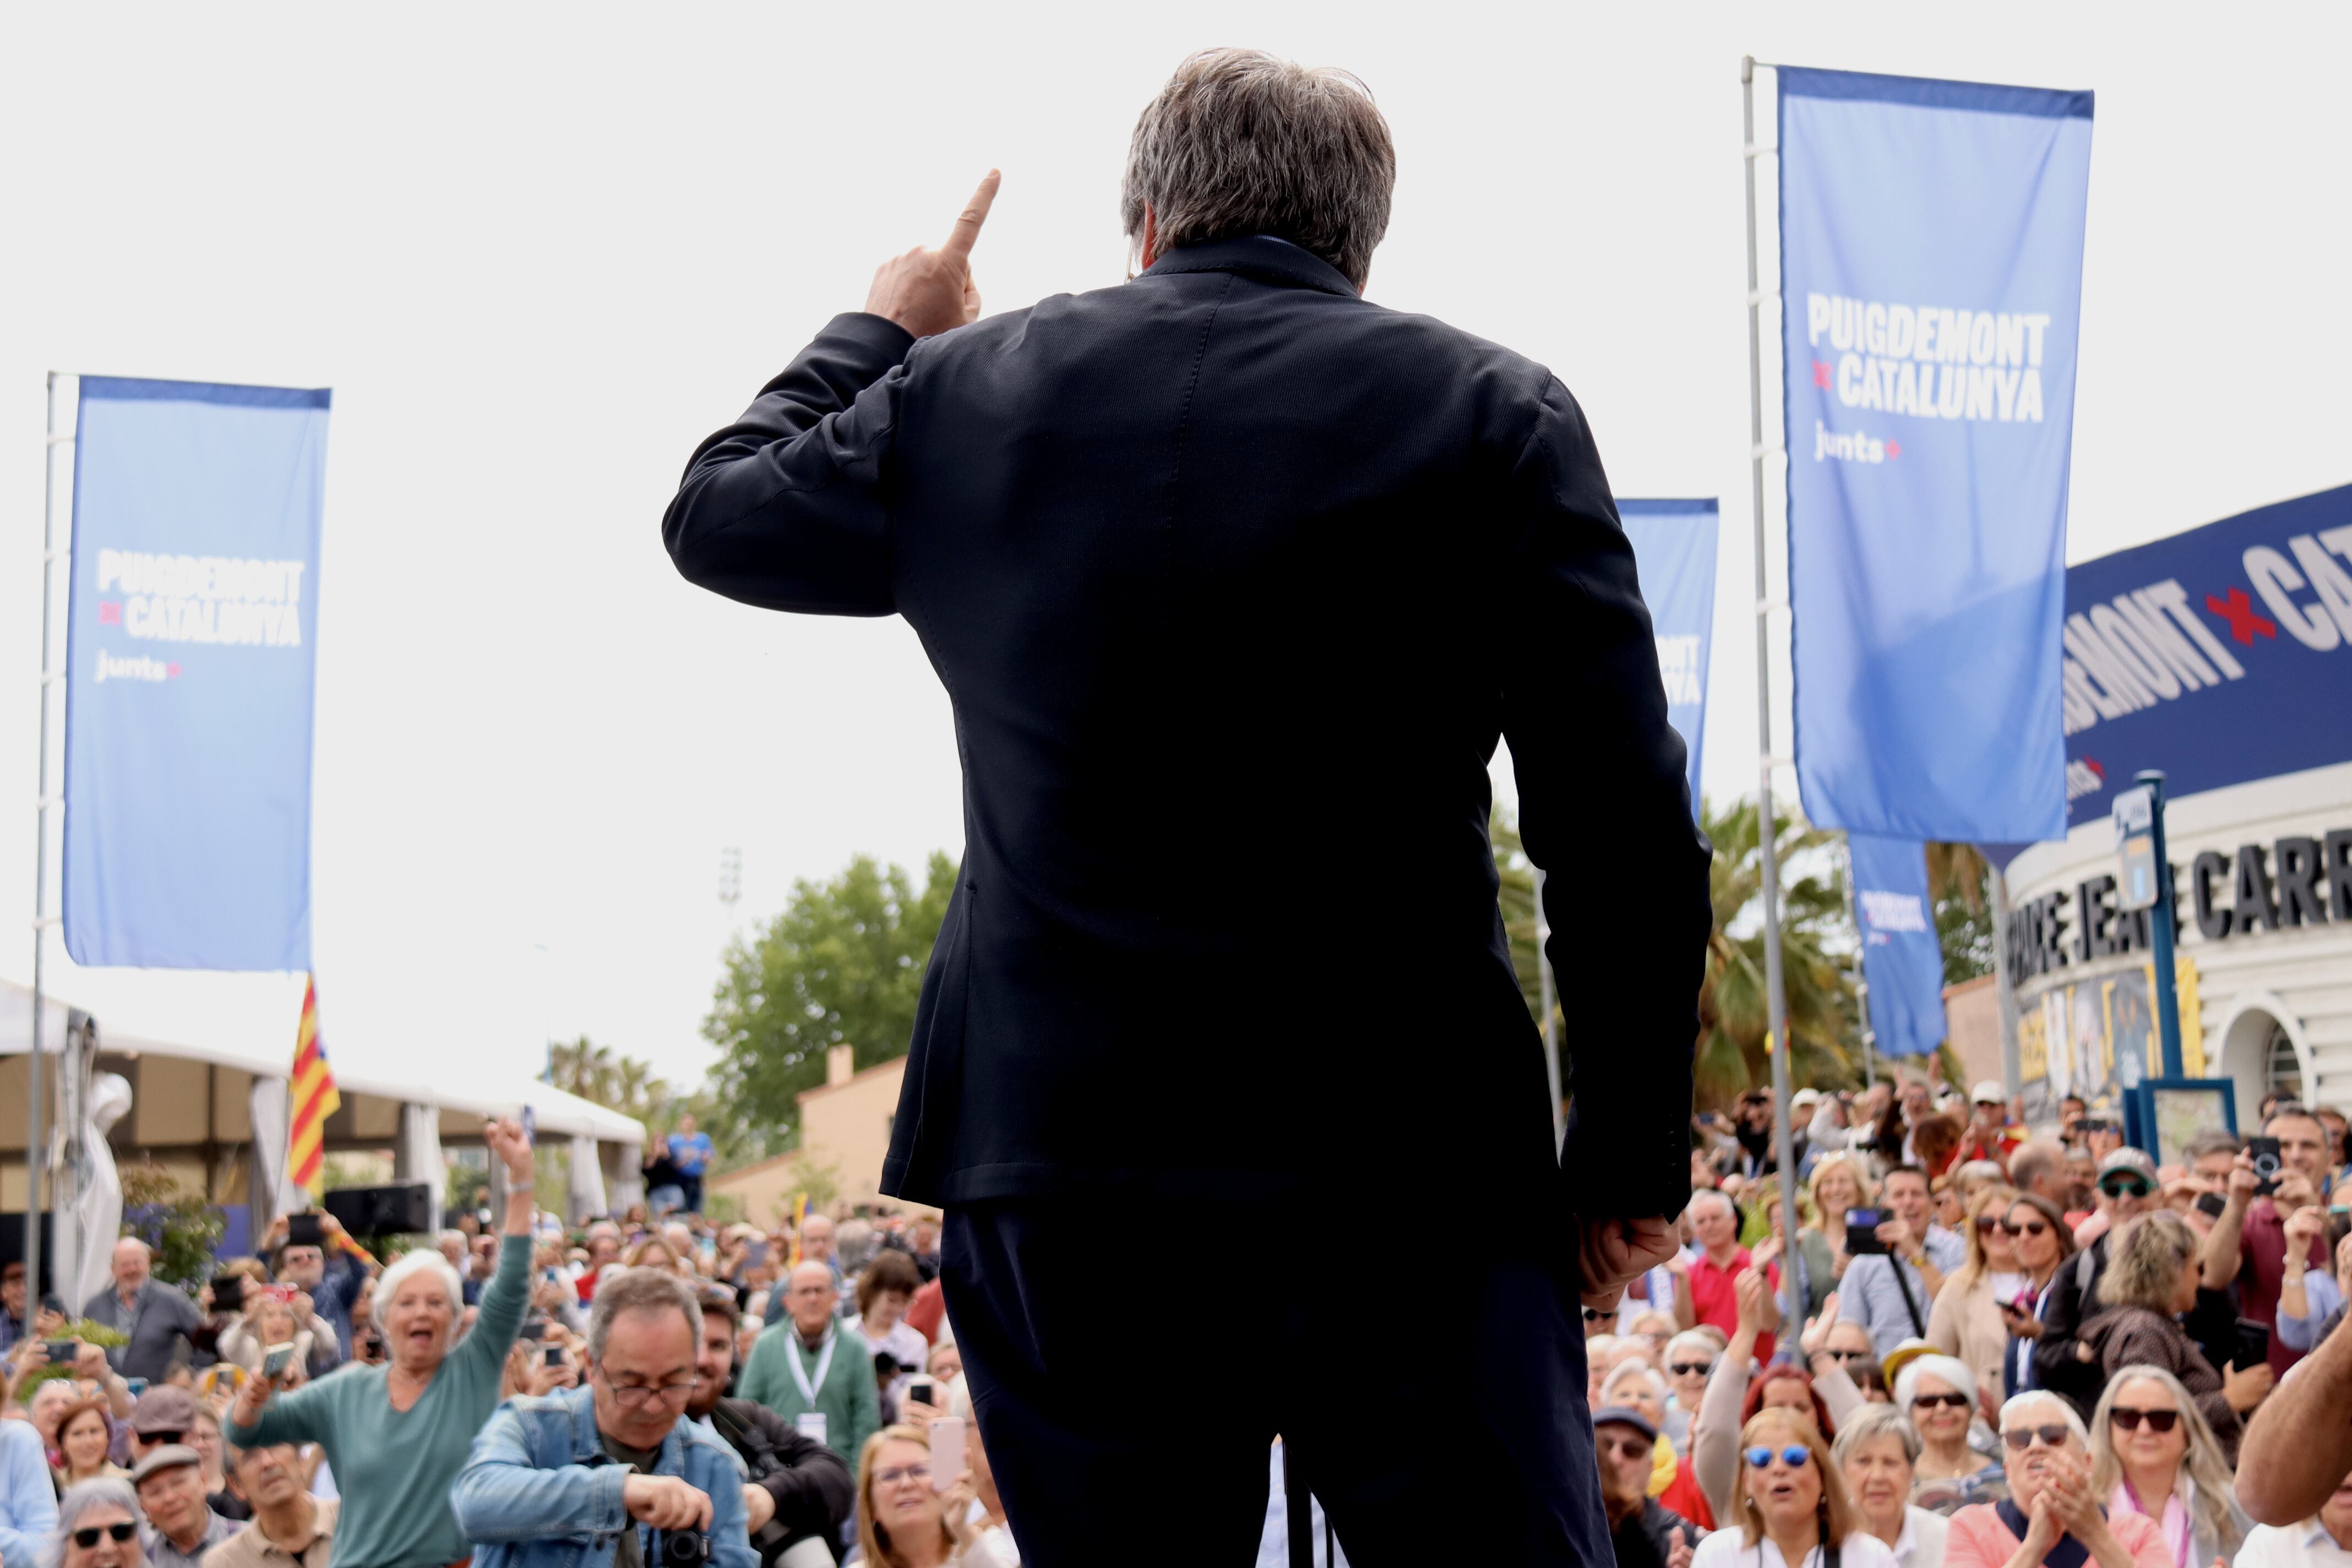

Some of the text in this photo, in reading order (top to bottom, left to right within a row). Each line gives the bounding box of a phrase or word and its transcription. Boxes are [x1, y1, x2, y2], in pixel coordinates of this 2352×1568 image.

[1808, 292, 2050, 366] PUIGDEMONT
[1837, 352, 2043, 422] CATALUNYA
[98, 549, 305, 602] PUIGDEMONT
[126, 596, 301, 645] CATALUNYA
